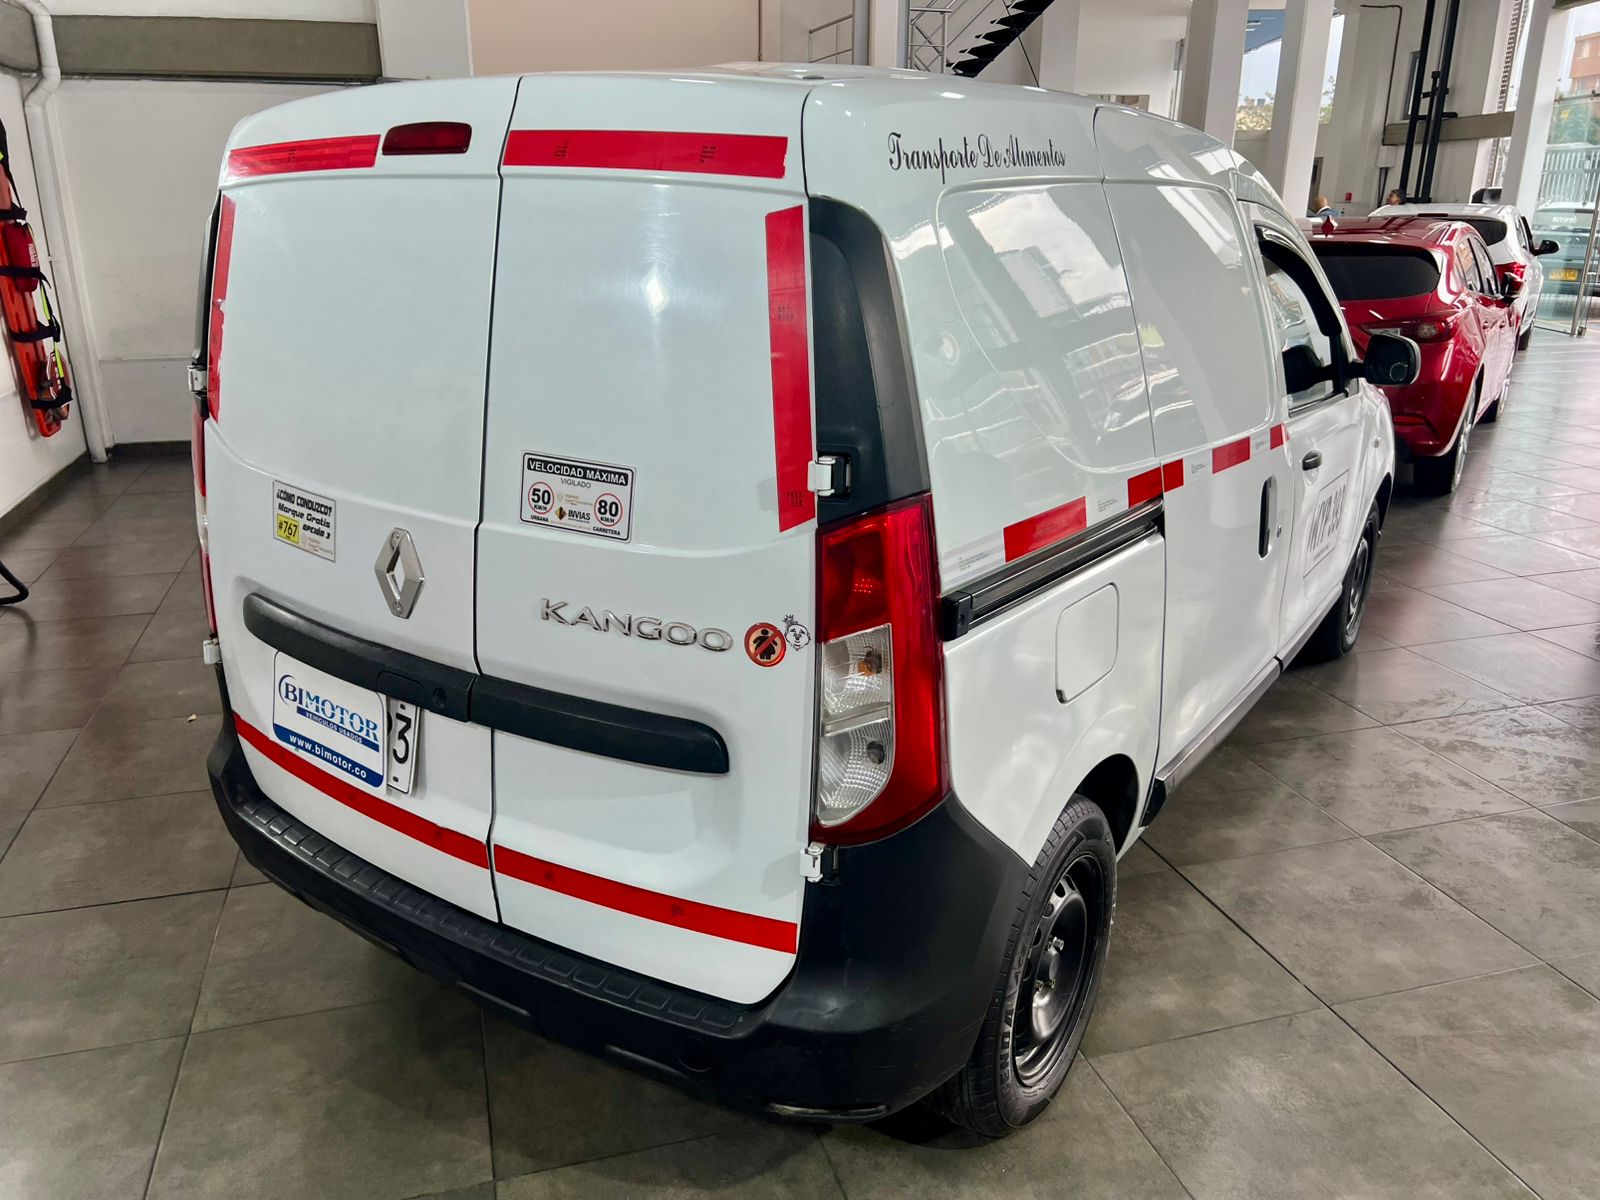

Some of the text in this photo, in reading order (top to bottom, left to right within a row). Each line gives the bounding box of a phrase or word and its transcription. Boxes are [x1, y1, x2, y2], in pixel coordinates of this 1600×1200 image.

[888, 132, 1066, 185] Transporte De Alimentos
[529, 460, 626, 485] VELOCIDAD MÁXIMA
[560, 478, 592, 489] VIGILADO
[531, 487, 551, 505] 50
[278, 502, 331, 529] Marque Gratis
[296, 496, 332, 517] CONDUZCO?
[568, 509, 591, 521] INVIAS
[597, 499, 619, 518] 80
[278, 520, 298, 537] #767
[325, 531, 331, 540] 3
[592, 526, 621, 536] CARRETERA
[540, 598, 734, 652] KANGOO
[284, 682, 379, 742] BIMOTOR
[339, 726, 363, 744] USADOS
[388, 711, 412, 765] 3
[289, 734, 368, 779] www.bimotor.co
